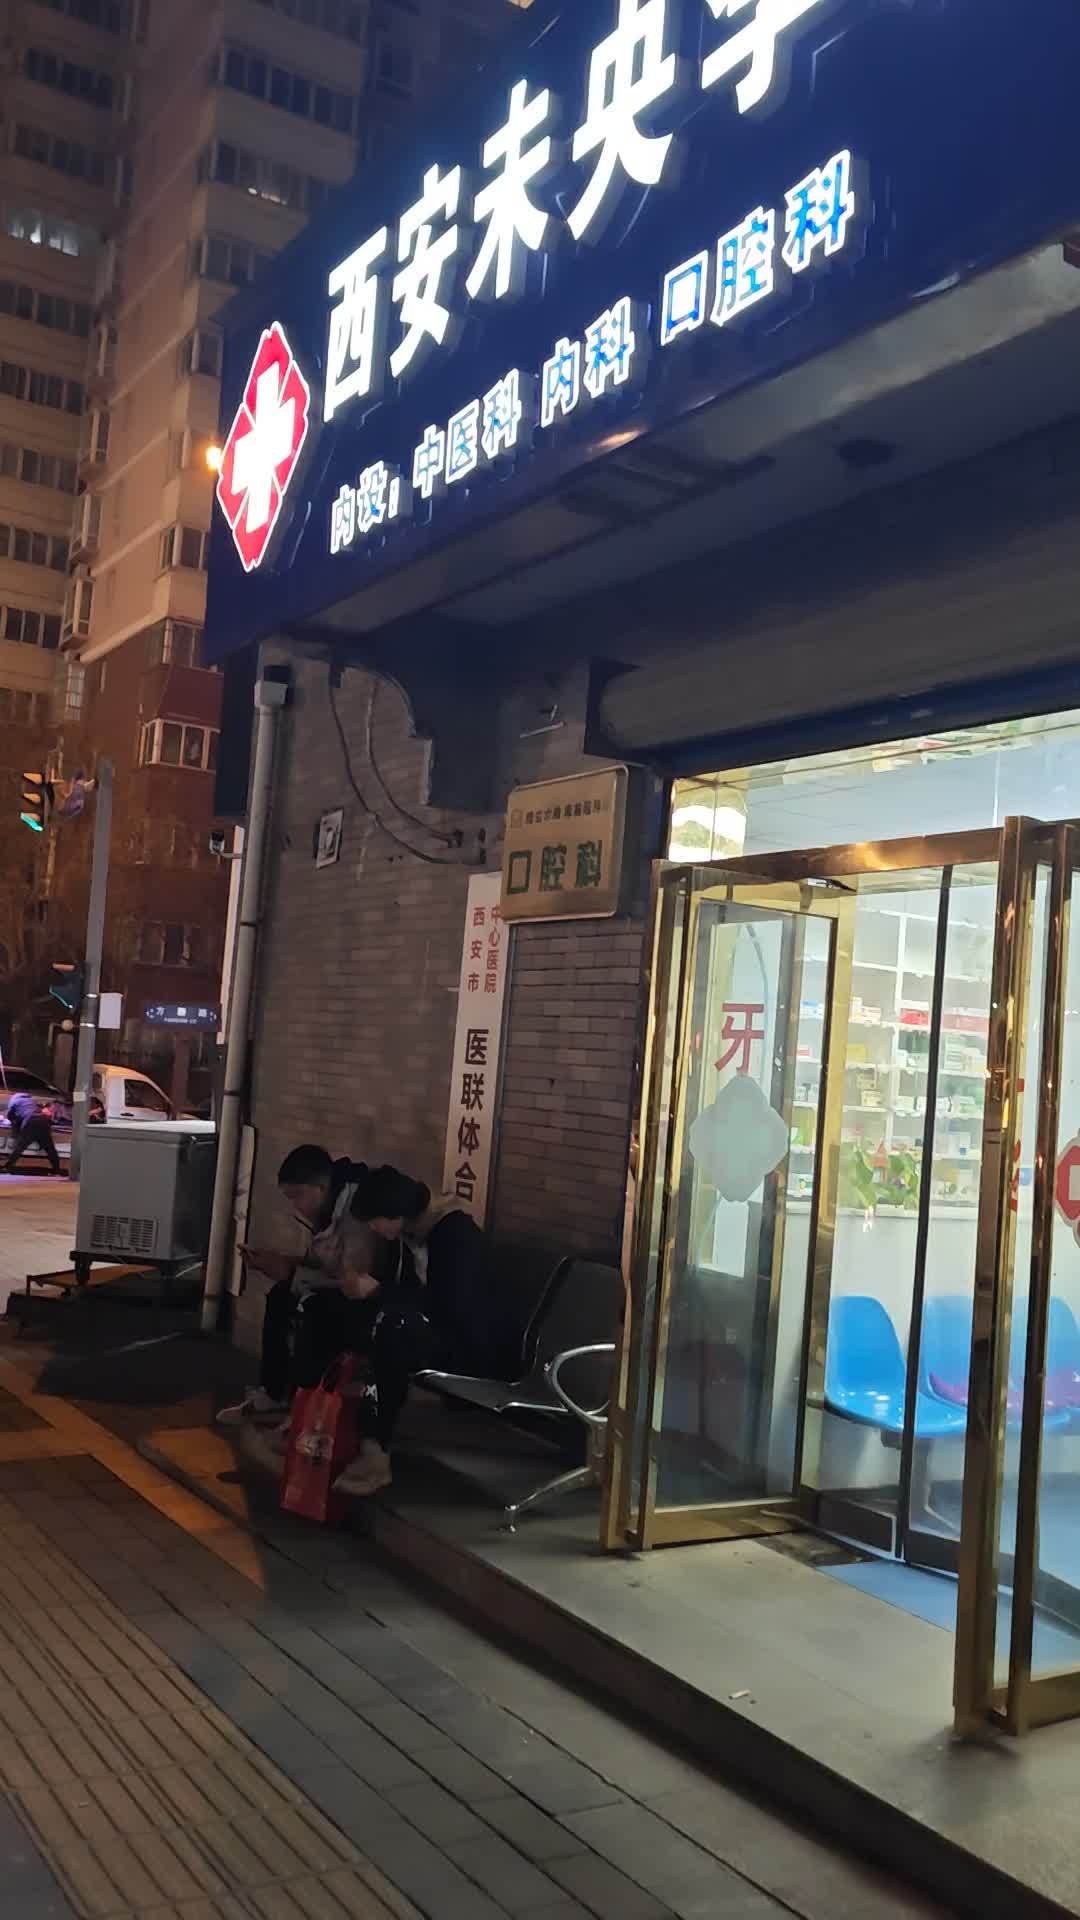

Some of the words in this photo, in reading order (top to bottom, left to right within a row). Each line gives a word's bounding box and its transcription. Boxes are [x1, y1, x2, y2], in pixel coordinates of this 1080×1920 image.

[541, 296, 635, 428] 内科
[660, 149, 854, 346] 口腔科
[507, 839, 603, 895] 口腔科
[467, 906, 486, 993] 西安市
[715, 1003, 765, 1074] 牙
[455, 1028, 489, 1202] 医联体合
